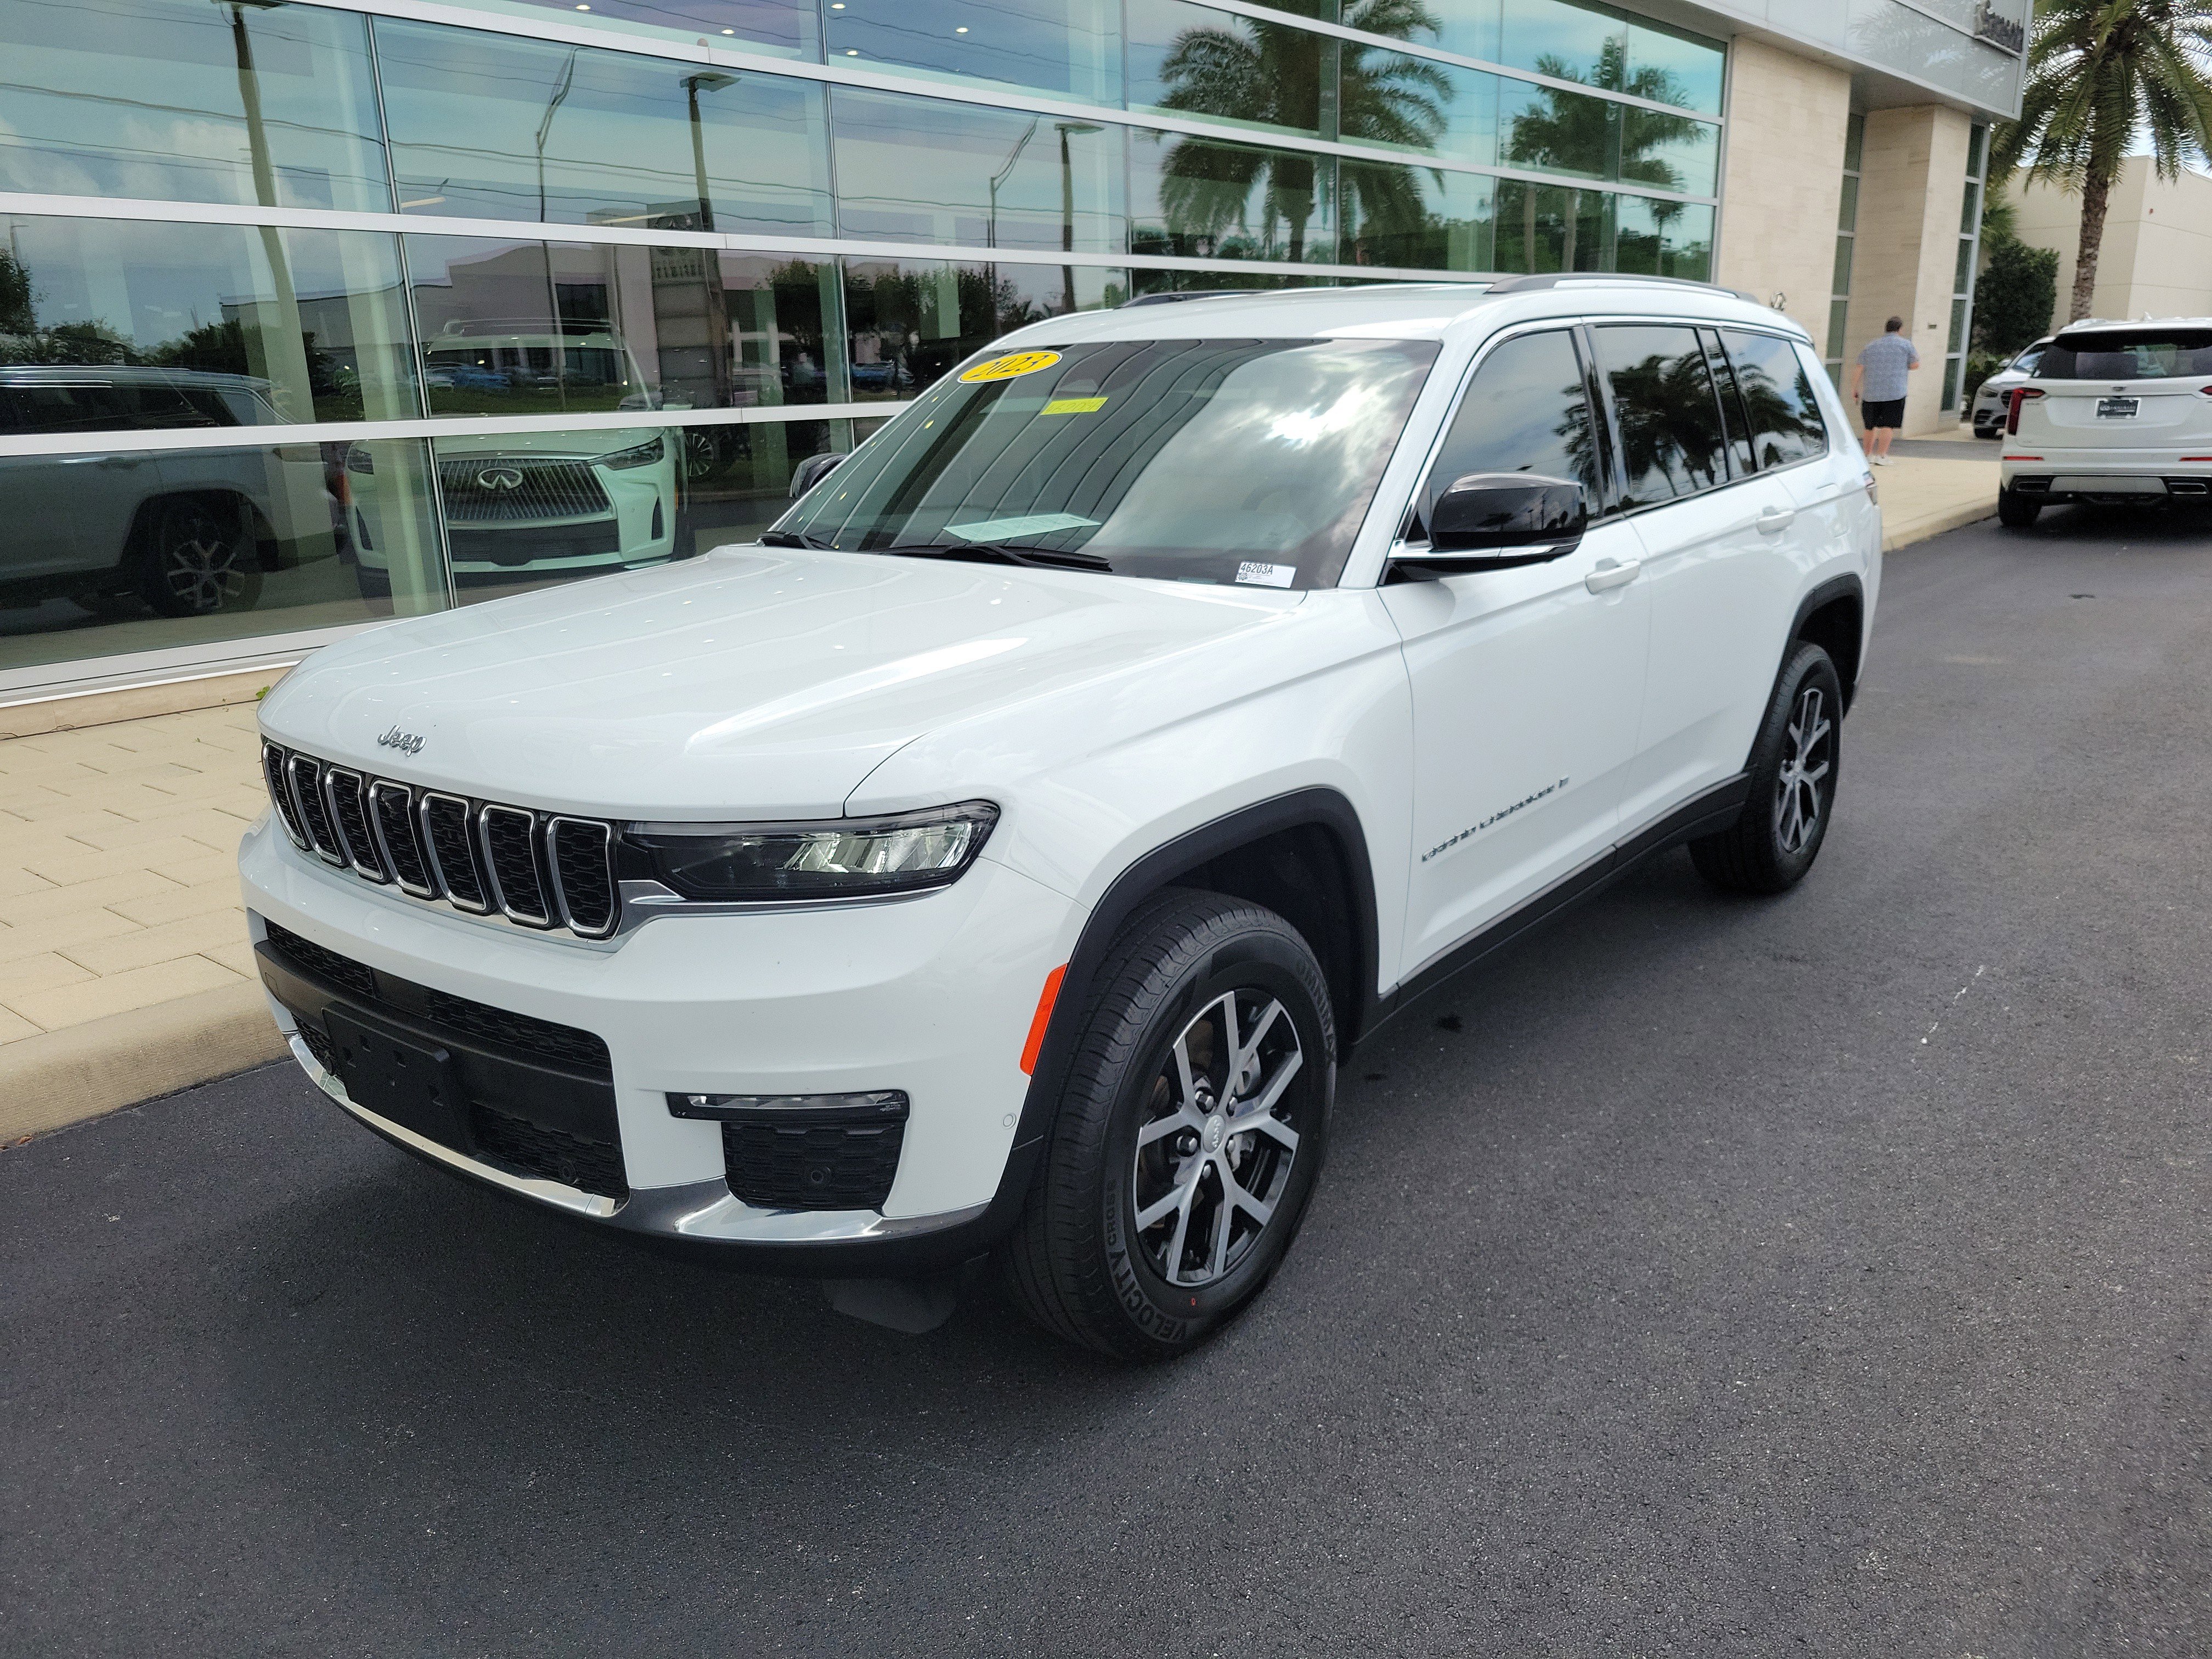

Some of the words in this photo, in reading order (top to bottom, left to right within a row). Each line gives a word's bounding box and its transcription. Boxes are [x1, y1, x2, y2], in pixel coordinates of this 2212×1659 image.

[1240, 563, 1273, 575] 46203A
[377, 725, 427, 757] Jeep
[1108, 1248, 1187, 1343] VELOCITY
